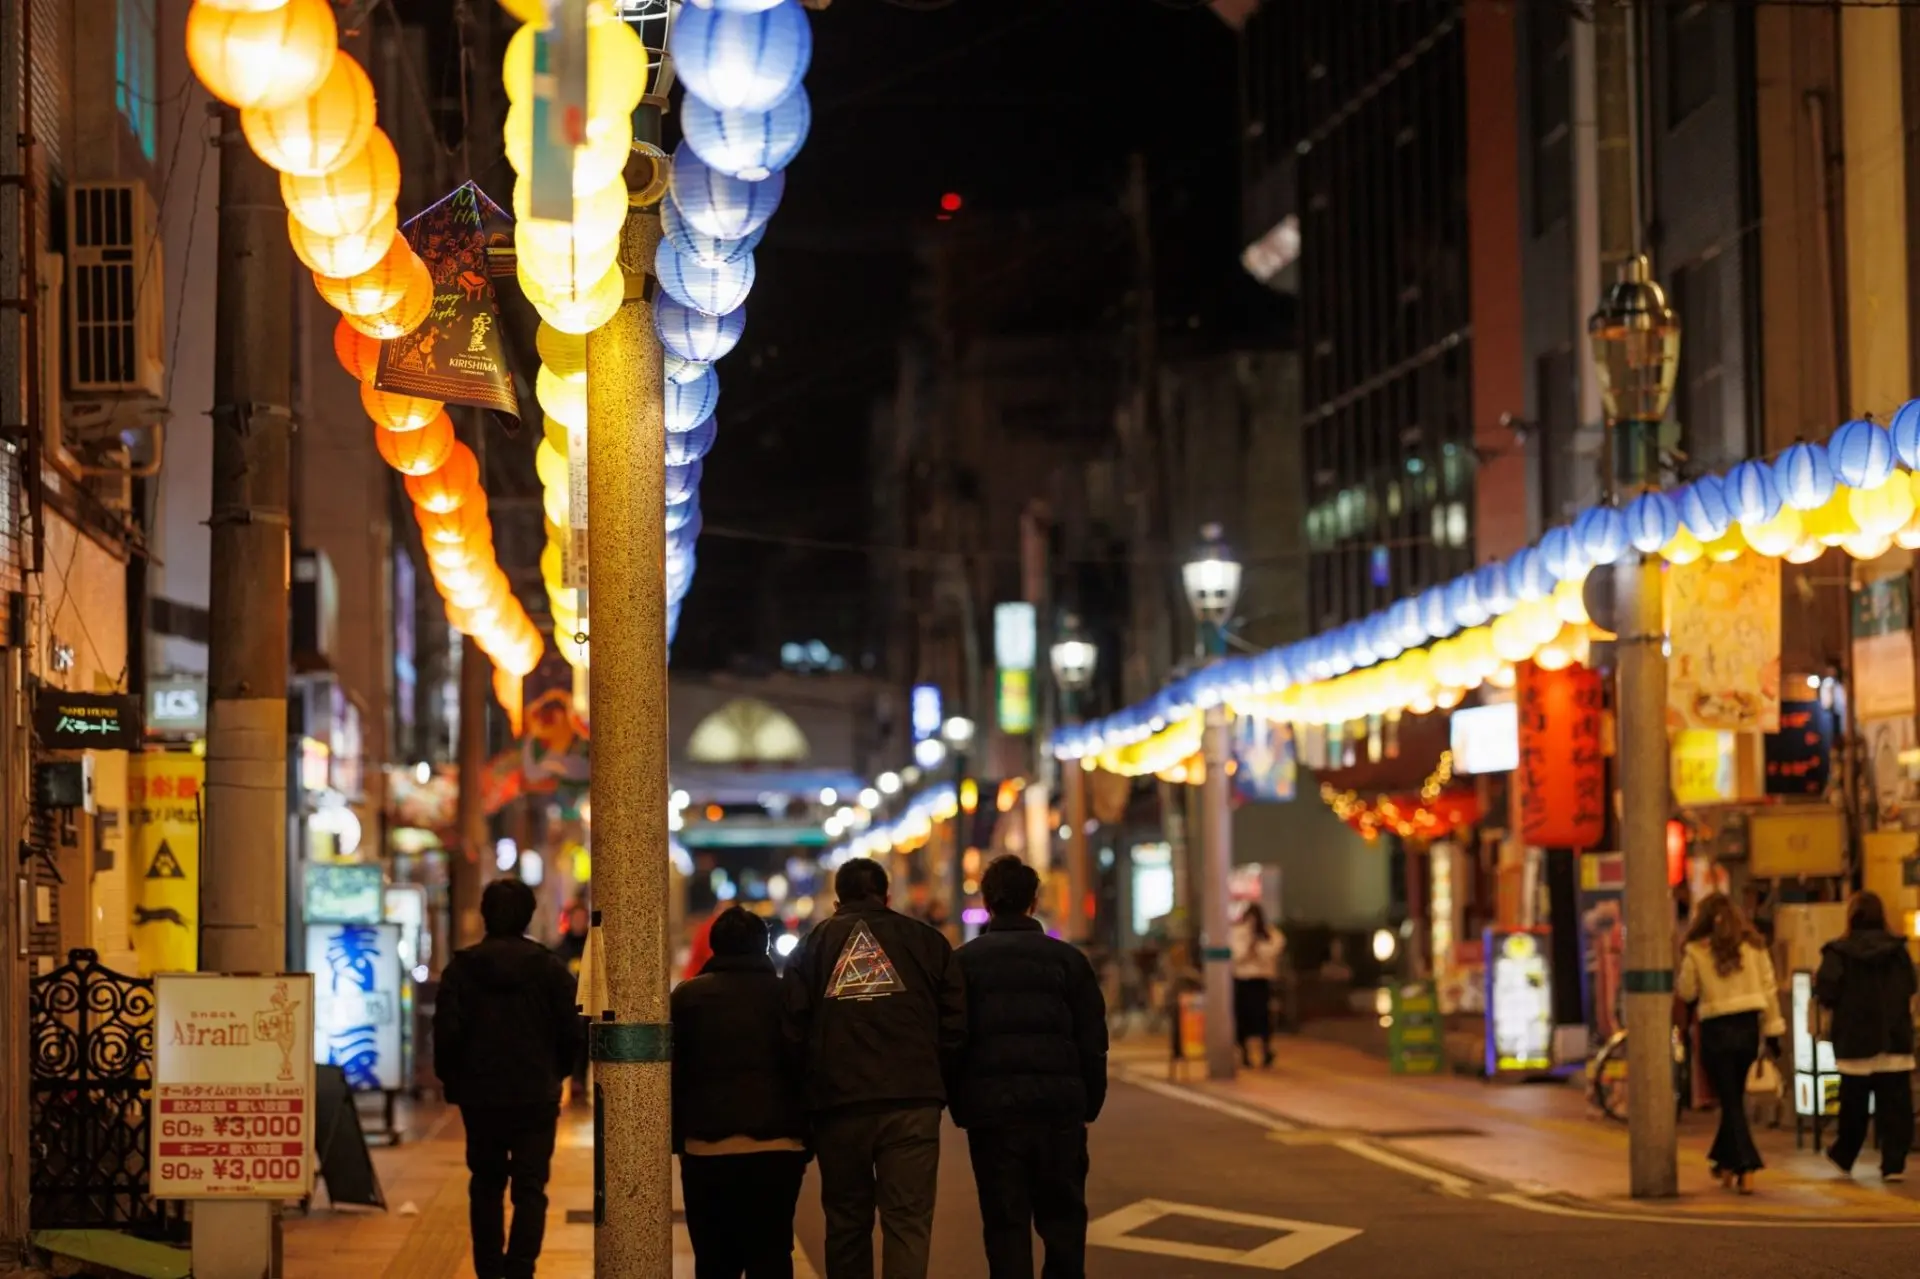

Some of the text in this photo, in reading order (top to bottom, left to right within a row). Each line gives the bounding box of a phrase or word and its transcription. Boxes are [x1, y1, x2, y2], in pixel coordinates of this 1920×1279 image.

[449, 358, 498, 373] KIRISHIMA
[55, 715, 121, 735] バラード
[162, 1115, 301, 1139] 60分 ¥3,000
[161, 1158, 301, 1183] 90分 ¥3,000
